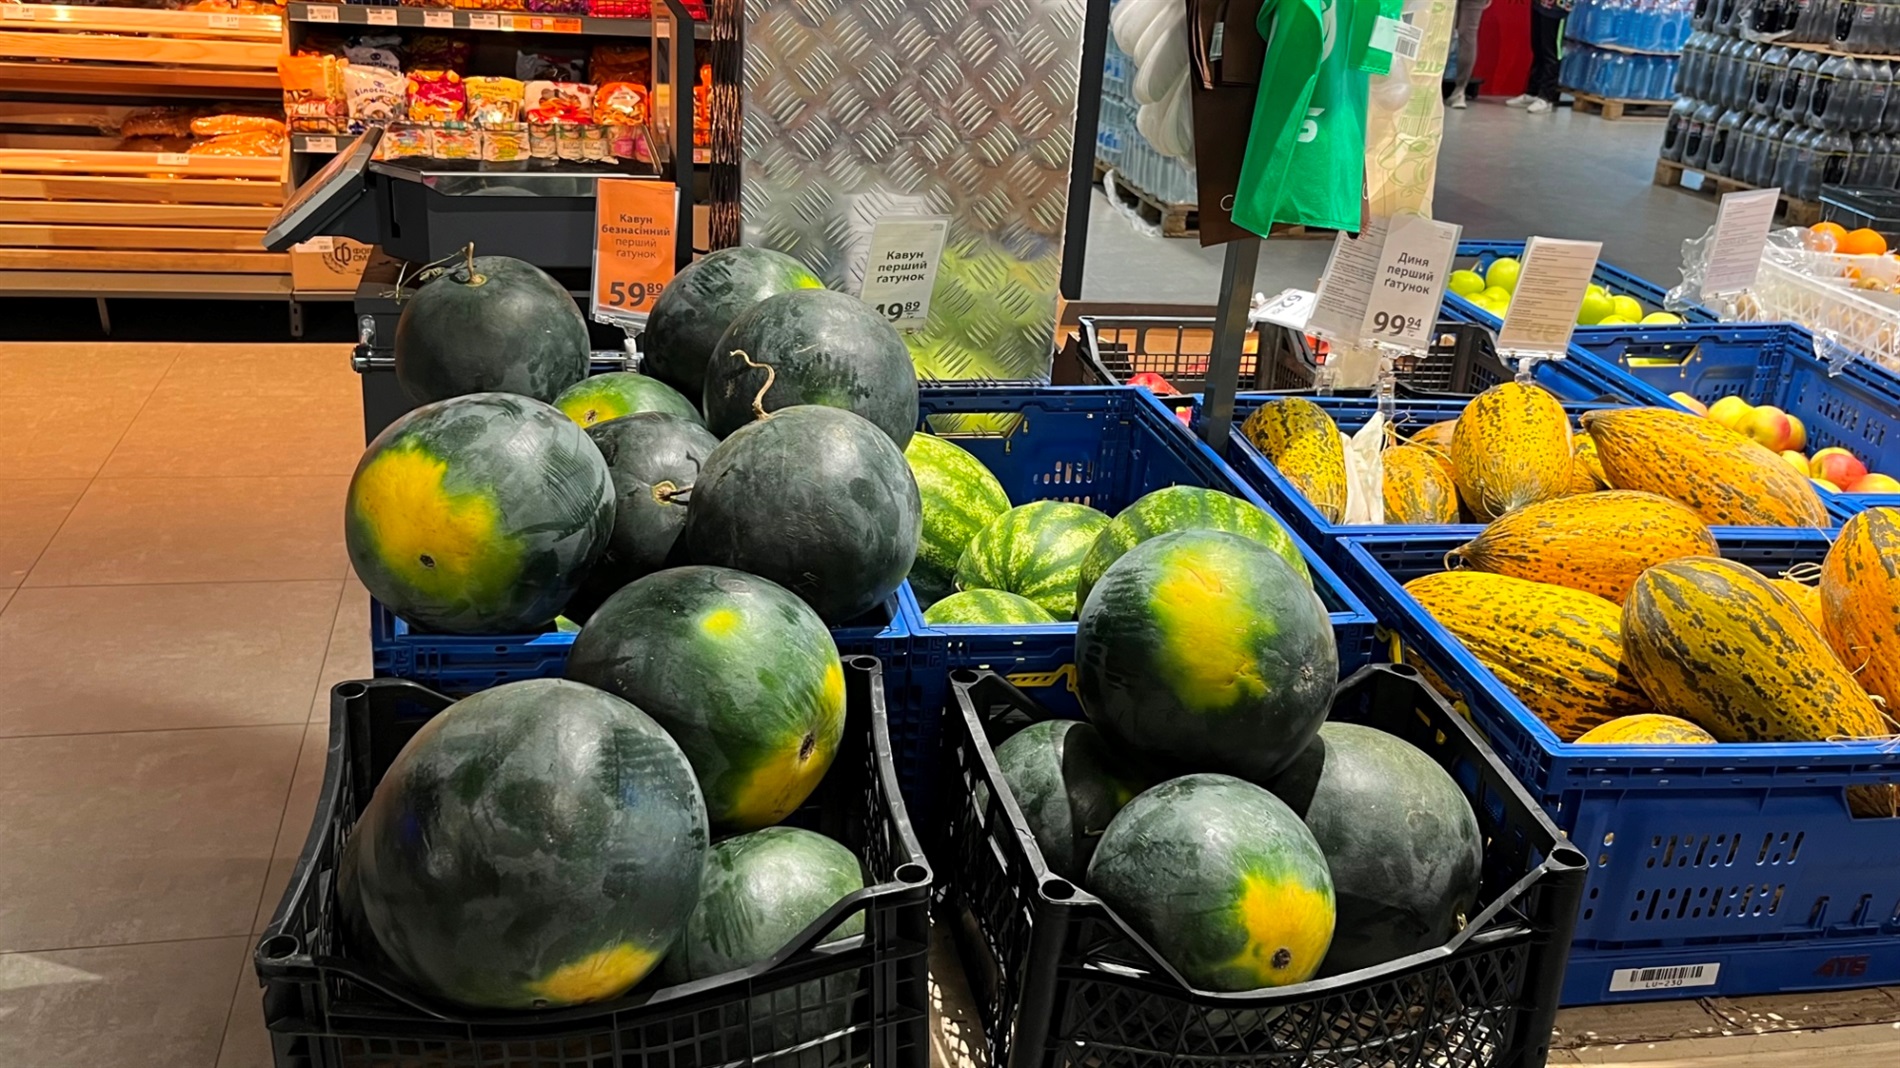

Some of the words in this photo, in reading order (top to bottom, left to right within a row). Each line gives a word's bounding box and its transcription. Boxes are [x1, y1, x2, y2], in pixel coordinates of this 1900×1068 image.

[619, 214, 653, 225] Кавун
[601, 224, 671, 236] безнасінний
[615, 238, 657, 248] перший
[886, 251, 924, 261] Кавун
[1397, 252, 1430, 267] Диня
[877, 261, 928, 273] перший
[876, 273, 925, 284] ґатунок
[1386, 265, 1434, 282] перший
[1384, 278, 1430, 295] ґатунок
[1372, 311, 1406, 337] 99
[1645, 979, 1683, 988] LU-230
